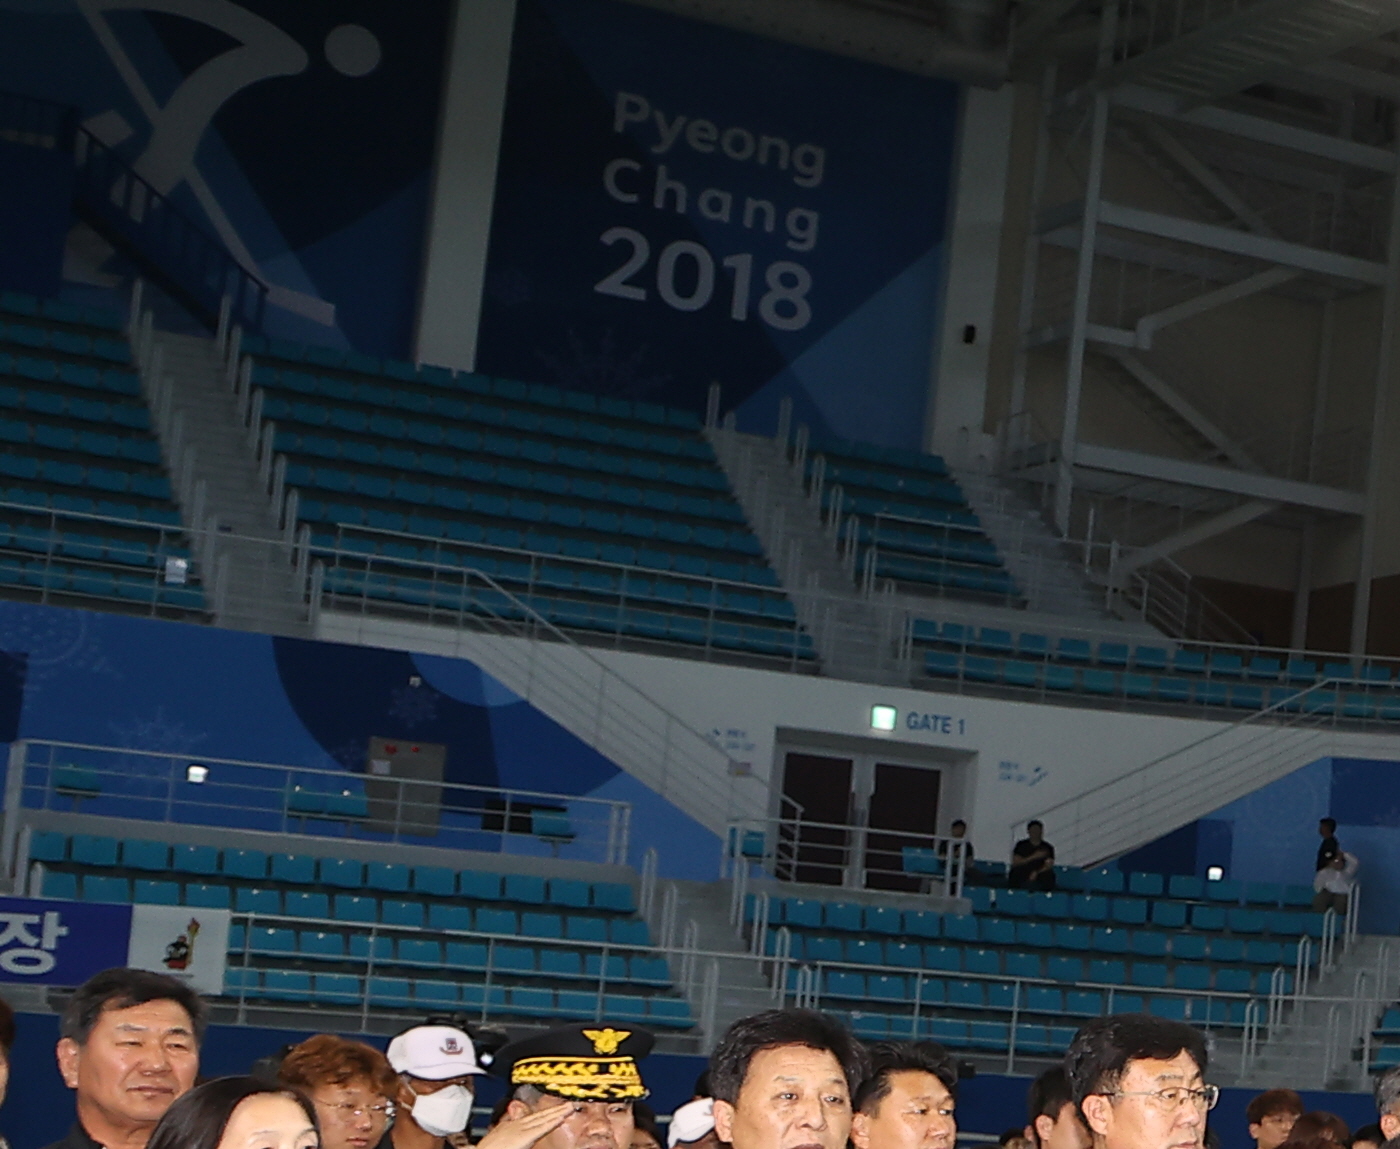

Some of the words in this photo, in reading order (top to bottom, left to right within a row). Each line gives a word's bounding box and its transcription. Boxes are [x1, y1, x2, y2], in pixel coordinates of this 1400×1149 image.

[615, 92, 825, 188] Pyeong
[603, 158, 819, 251] Chang
[594, 226, 812, 331] 2018
[906, 711, 951, 735] GATE
[958, 719, 966, 735] 1
[0, 911, 69, 975] 장
